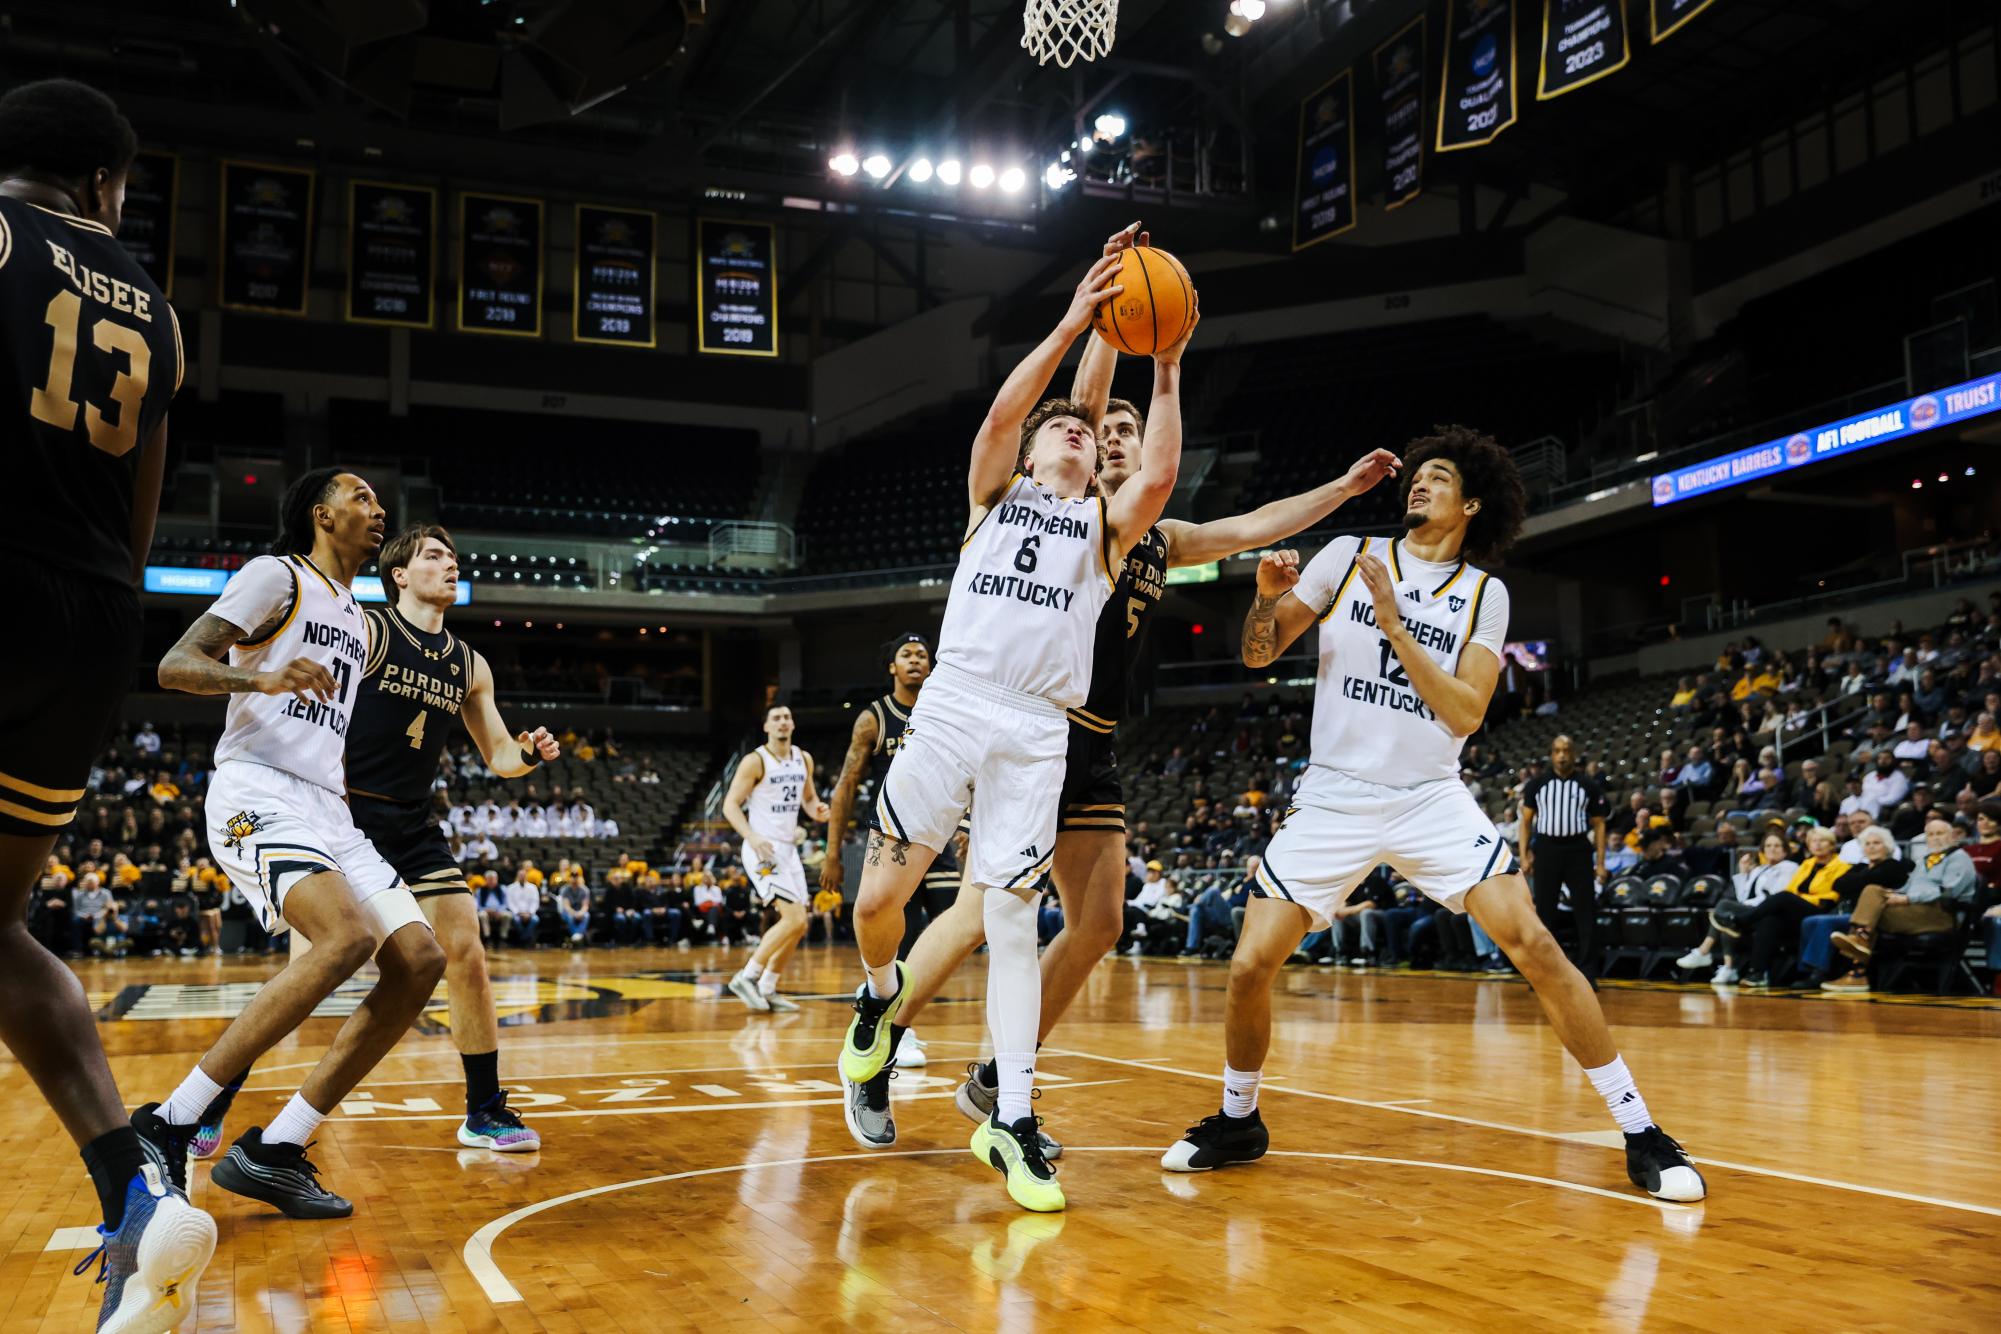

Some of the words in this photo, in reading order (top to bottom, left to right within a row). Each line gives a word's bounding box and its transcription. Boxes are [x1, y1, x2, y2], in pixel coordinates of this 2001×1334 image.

[1566, 40, 1605, 74] 2023
[46, 239, 152, 323] ELISEE
[30, 289, 152, 458] 13
[1943, 382, 1995, 415] TRUIST
[1840, 410, 1905, 446] FOOTBALL
[1677, 463, 1731, 492] KENTUCKY
[1732, 446, 1783, 478] BARRELS
[1014, 535, 1041, 575] 6
[968, 572, 1075, 612] KENTUCKY
[1126, 596, 1147, 639] 5
[1350, 600, 1457, 654] NOHERN
[331, 656, 352, 705] 11
[1378, 638, 1410, 687] 12
[378, 679, 422, 700] FORT
[422, 690, 460, 715] WAYNE
[383, 663, 464, 703] PURDUE
[405, 709, 428, 750] 4
[782, 785, 798, 802] 24
